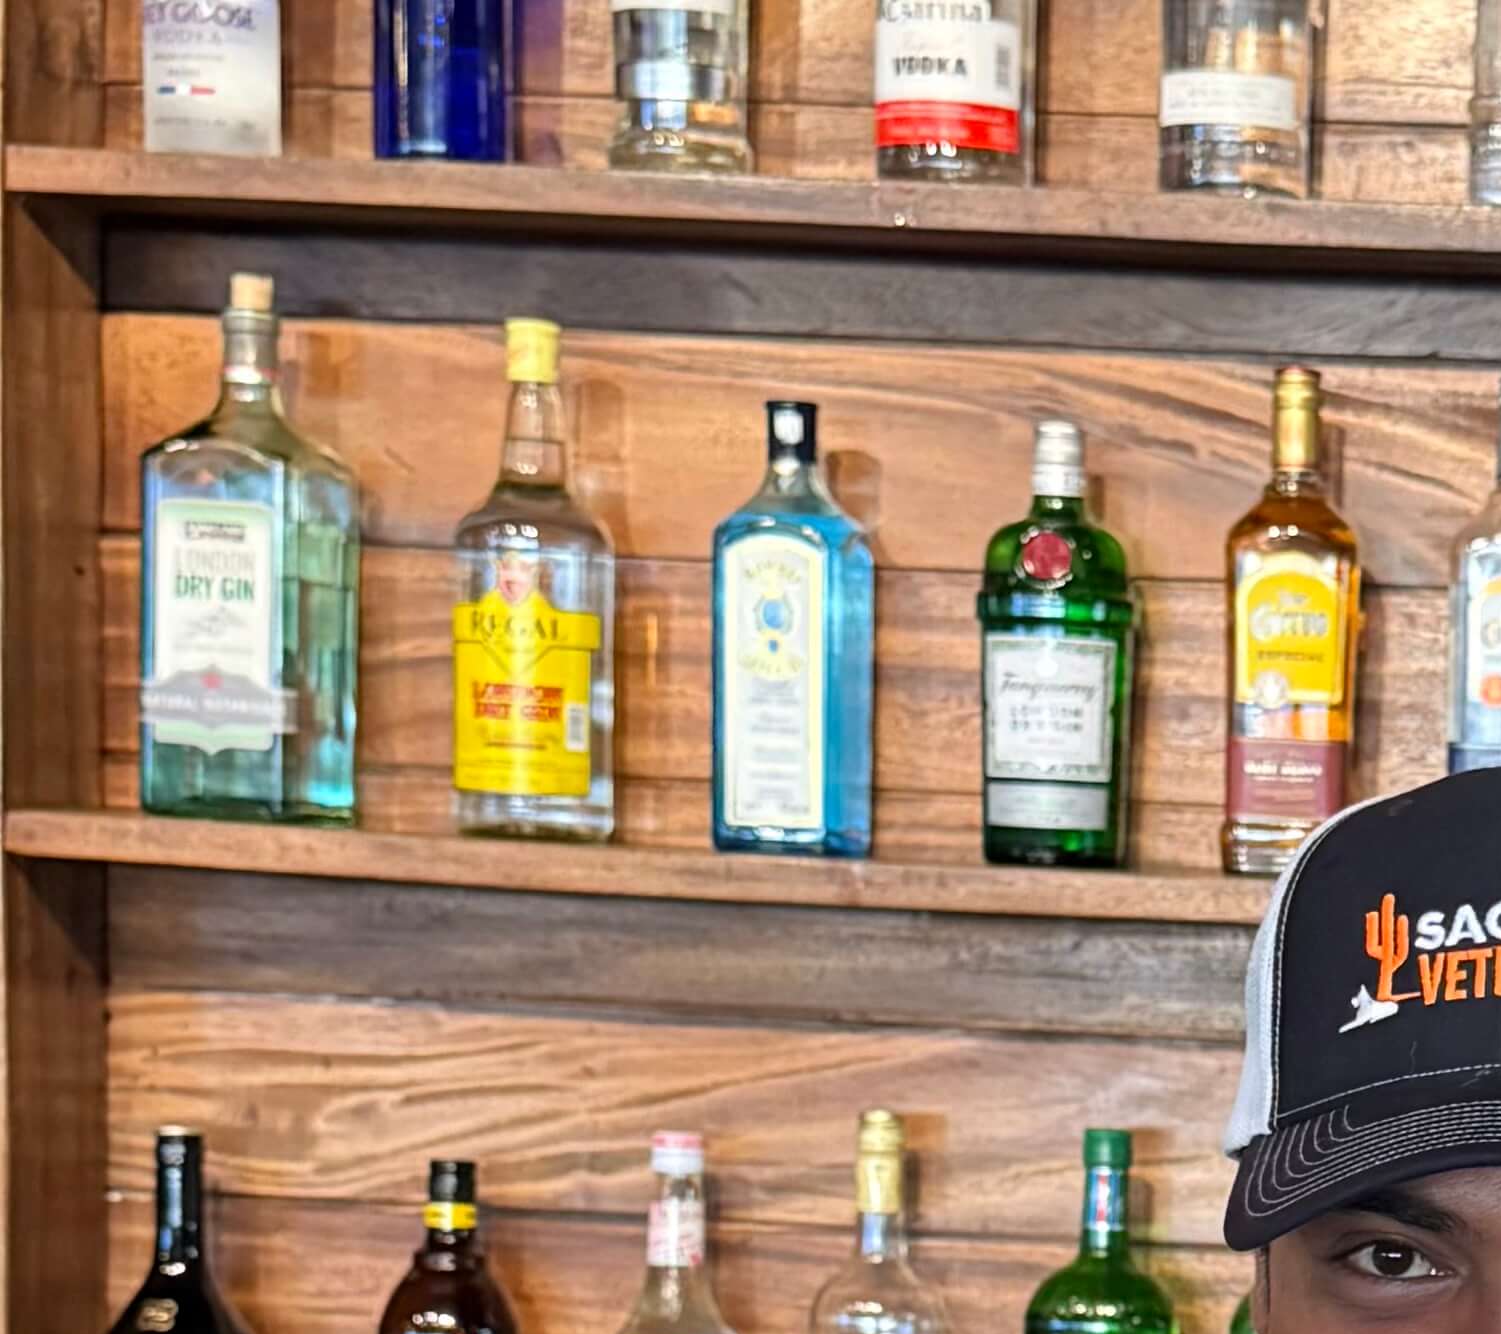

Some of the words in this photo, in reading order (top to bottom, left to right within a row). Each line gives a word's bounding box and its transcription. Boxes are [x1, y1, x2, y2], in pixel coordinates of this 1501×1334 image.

[893, 56, 968, 76] VODKA
[174, 574, 212, 600] DRY
[221, 576, 255, 603] GIN
